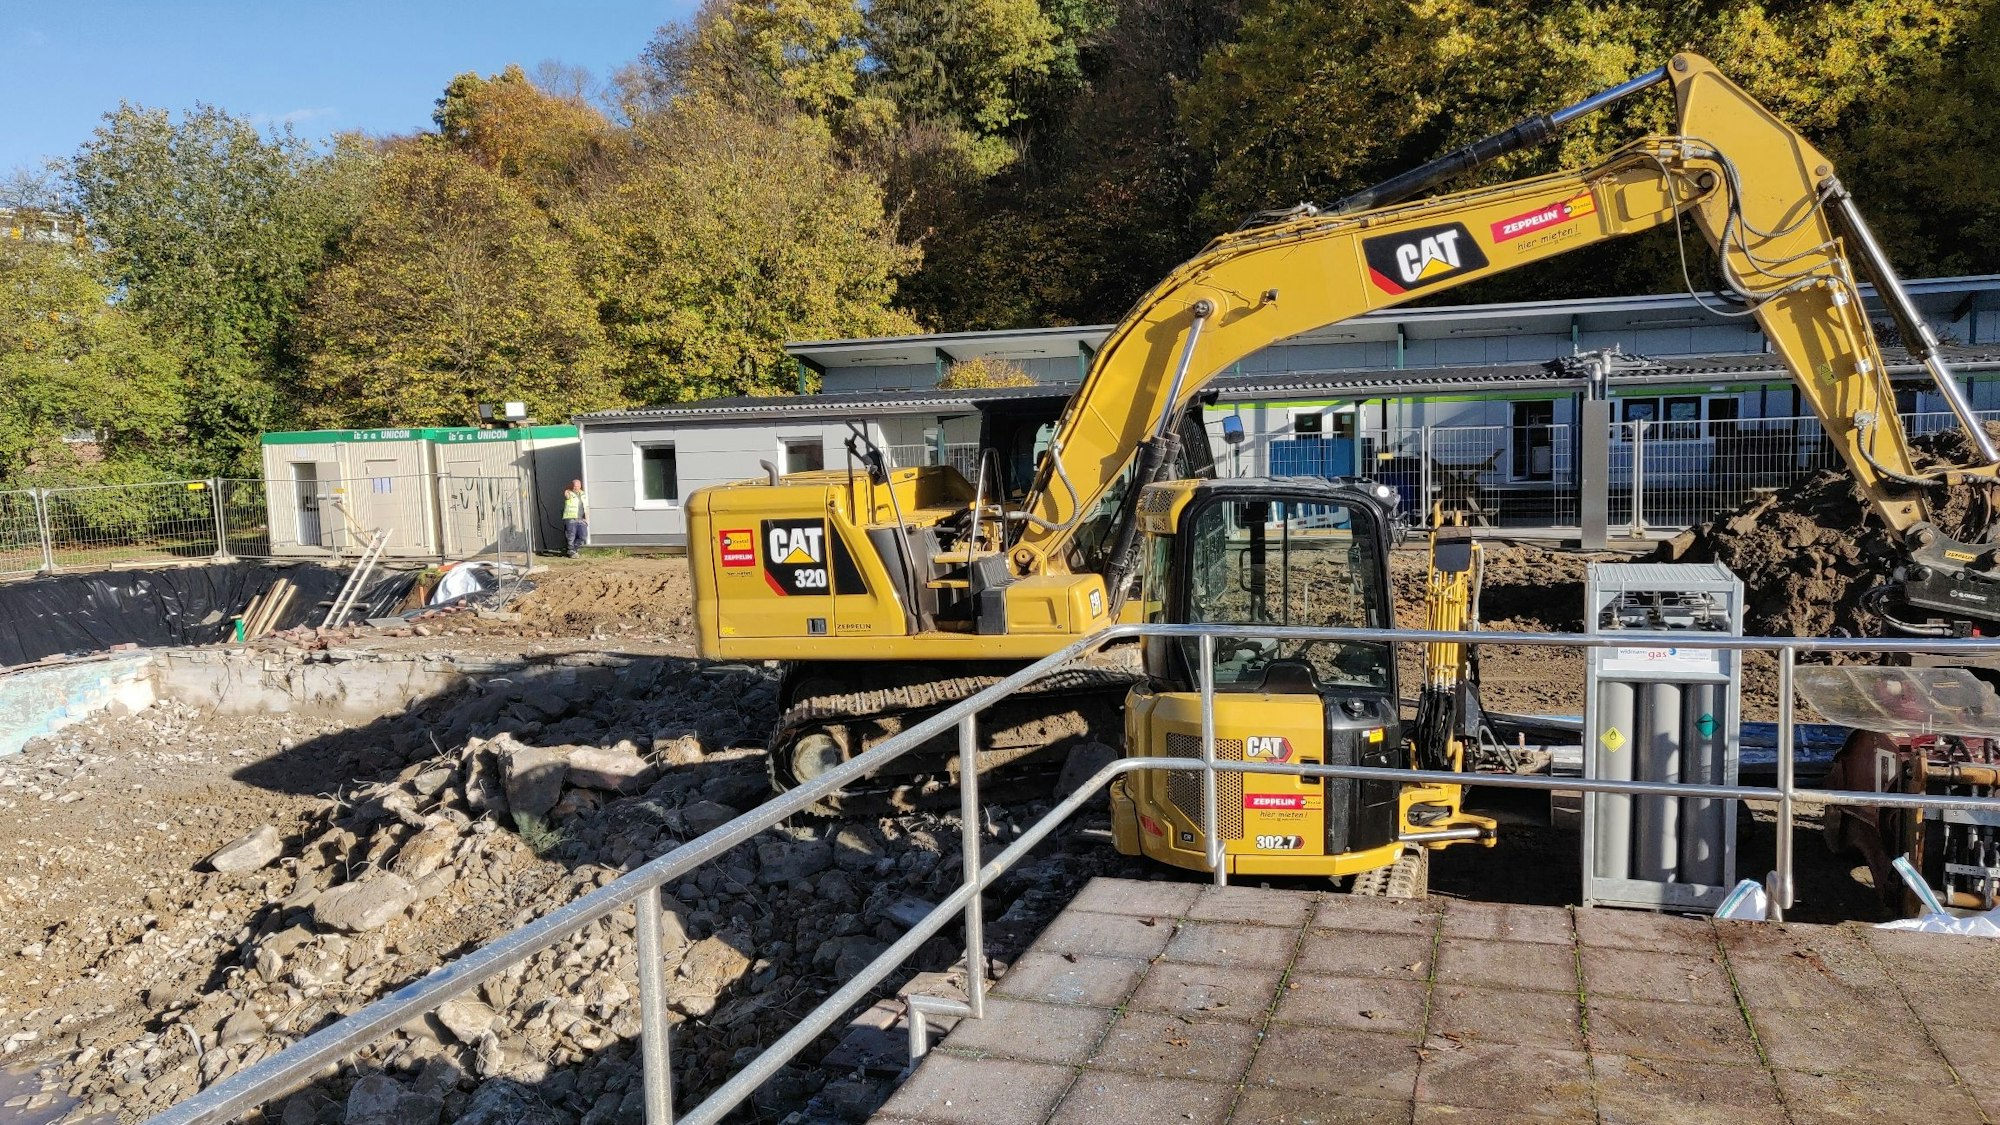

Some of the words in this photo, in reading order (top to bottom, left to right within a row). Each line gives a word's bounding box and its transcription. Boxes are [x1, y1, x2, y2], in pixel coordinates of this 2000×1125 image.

[1502, 209, 1559, 235] ZEPPELIN
[1517, 239, 1537, 251] hier
[1396, 228, 1461, 283] CAT
[380, 430, 410, 439] UNICON
[477, 430, 508, 440] UNICON
[769, 527, 823, 564] CAT
[794, 568, 827, 588] 320
[1648, 651, 1667, 660] gas
[1247, 736, 1283, 759] CAT
[1253, 797, 1296, 806] ZEPPELIN
[1259, 810, 1276, 818] hier
[1256, 835, 1297, 849] 302.7
